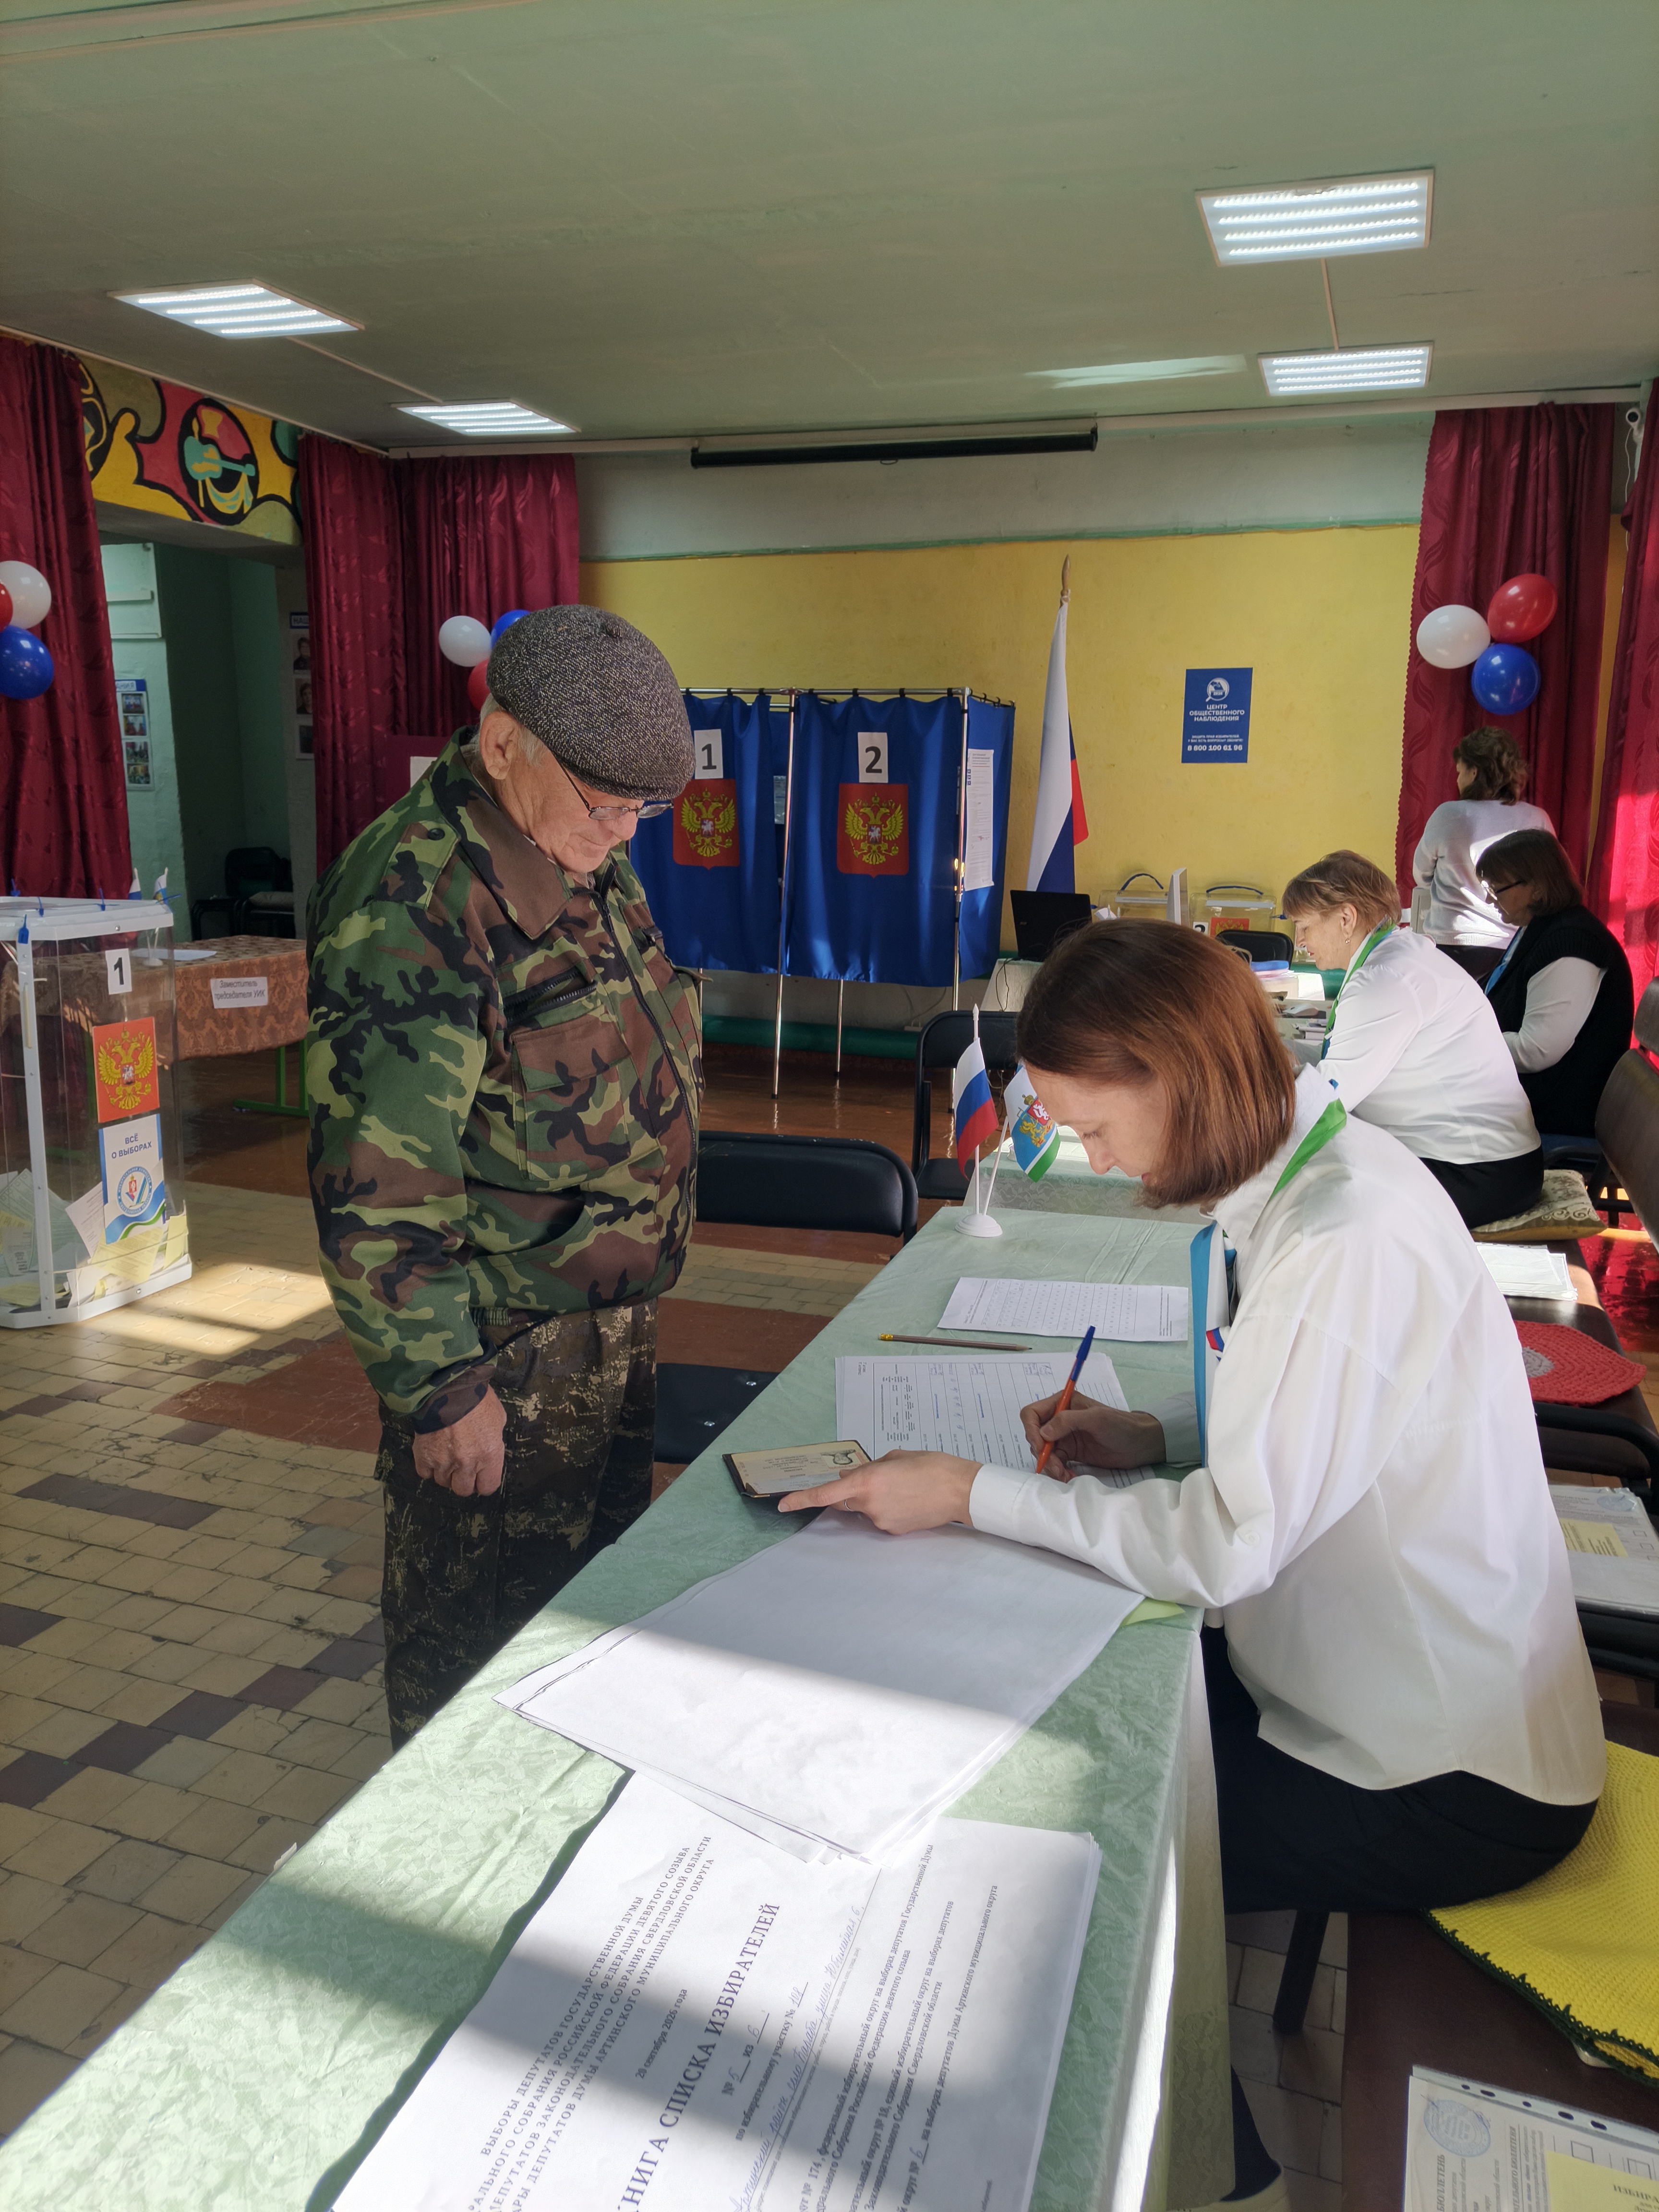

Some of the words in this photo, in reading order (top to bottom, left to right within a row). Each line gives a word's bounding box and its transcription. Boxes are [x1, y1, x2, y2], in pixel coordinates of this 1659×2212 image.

[702, 744, 717, 769] 1
[866, 746, 882, 773] 2
[114, 957, 124, 985] 1
[219, 980, 258, 988] Заместитель
[253, 989, 265, 998] УИК
[119, 1141, 152, 1157] ВЫБОРАХ
[125, 1132, 138, 1144] ВСЁ
[920, 1843, 934, 1863] Думы
[901, 1863, 927, 1919] Государственной
[986, 1884, 998, 1909] округа
[938, 1899, 954, 1935] депутатов
[890, 1919, 908, 1955] депутатов
[927, 1935, 943, 1966] выборах
[969, 1908, 992, 1968] муниципального
[536, 2007, 613, 2128] ЗАКОНОДАТЕЛЬНОГО
[610, 1947, 646, 2004] СОБРАНИЯ
[641, 1875, 688, 1945] СВЕРДЛОВСКОЙ
[684, 1835, 711, 1874] ОБЛАСТИ
[878, 1954, 895, 1986] выборах
[924, 1966, 933, 1976] на
[513, 2068, 557, 2135] СОБРАНИЯ
[553, 1991, 604, 2067] РОССИЙСКОЙ
[600, 1928, 640, 1989] ФЕДЕРАЦИИ
[636, 1881, 668, 1927] ДЕВЯТОГО
[664, 1846, 690, 1879] СОЗЫВА
[787, 1986, 805, 2006] 108
[875, 1986, 883, 1997] на
[916, 1976, 930, 1999] округ
[954, 1968, 975, 2013] Артинского
[527, 2102, 576, 2183] ДЕПУТАТОВ
[572, 2064, 599, 2100] ДУМЫ
[595, 1987, 641, 2063] АРТИНСКОГО
[636, 1893, 694, 1985] МУНИЦИПАЛЬНОГО
[689, 1858, 714, 1892] ОКРУГА
[785, 2008, 795, 2019] №
[866, 1997, 879, 2022] округ
[481, 2098, 520, 2156] ВЫБОРЫ
[516, 2030, 564, 2096] ДЕПУТАТОВ
[560, 1924, 625, 2028] ГОСУДАРСТВЕННОЙ
[621, 1896, 643, 1923] ДУМЫ
[635, 2067, 647, 2079] 20
[643, 2030, 669, 2068] сентября
[662, 2008, 678, 2030] 2026
[673, 1988, 687, 2008] года
[771, 2019, 793, 2057] участку
[896, 1999, 923, 2068] избирательный
[946, 2013, 962, 2040] Думы
[616, 2134, 669, 2212] НИГА
[658, 2040, 716, 2129] СПИСКА
[704, 1901, 780, 2037] ИЗБИРАТЕЛЕЙ
[721, 2080, 736, 2096] №
[742, 2044, 754, 2058] из
[841, 2022, 871, 2093] избирательный
[936, 2039, 955, 2087] депутатов
[741, 2056, 779, 2127] избирательному
[816, 2161, 839, 2212] рального
[830, 2113, 855, 2160] Собрания
[848, 2060, 874, 2114] Российской
[866, 2010, 890, 2060] Федерации
[885, 1975, 902, 2010] девятого
[896, 1948, 911, 1975] созыва
[864, 2122, 901, 2211] Законодательного
[892, 2077, 915, 2122] Собрания
[907, 2011, 933, 2076] Свердловской
[926, 1980, 943, 2012] области
[885, 2068, 901, 2104] единый
[924, 2087, 941, 2128] выборах
[735, 2128, 746, 2141] по
[816, 2093, 847, 2156] федеральный
[873, 2117, 885, 2131] №
[920, 2128, 931, 2141] на
[866, 2130, 882, 2160] округ
[908, 2146, 924, 2159] 6
[908, 2160, 921, 2175] №
[1437, 2154, 1445, 2212] БЮЛЛЕТЕНЬ
[801, 2182, 812, 2197] №
[902, 2175, 918, 2206] округ
